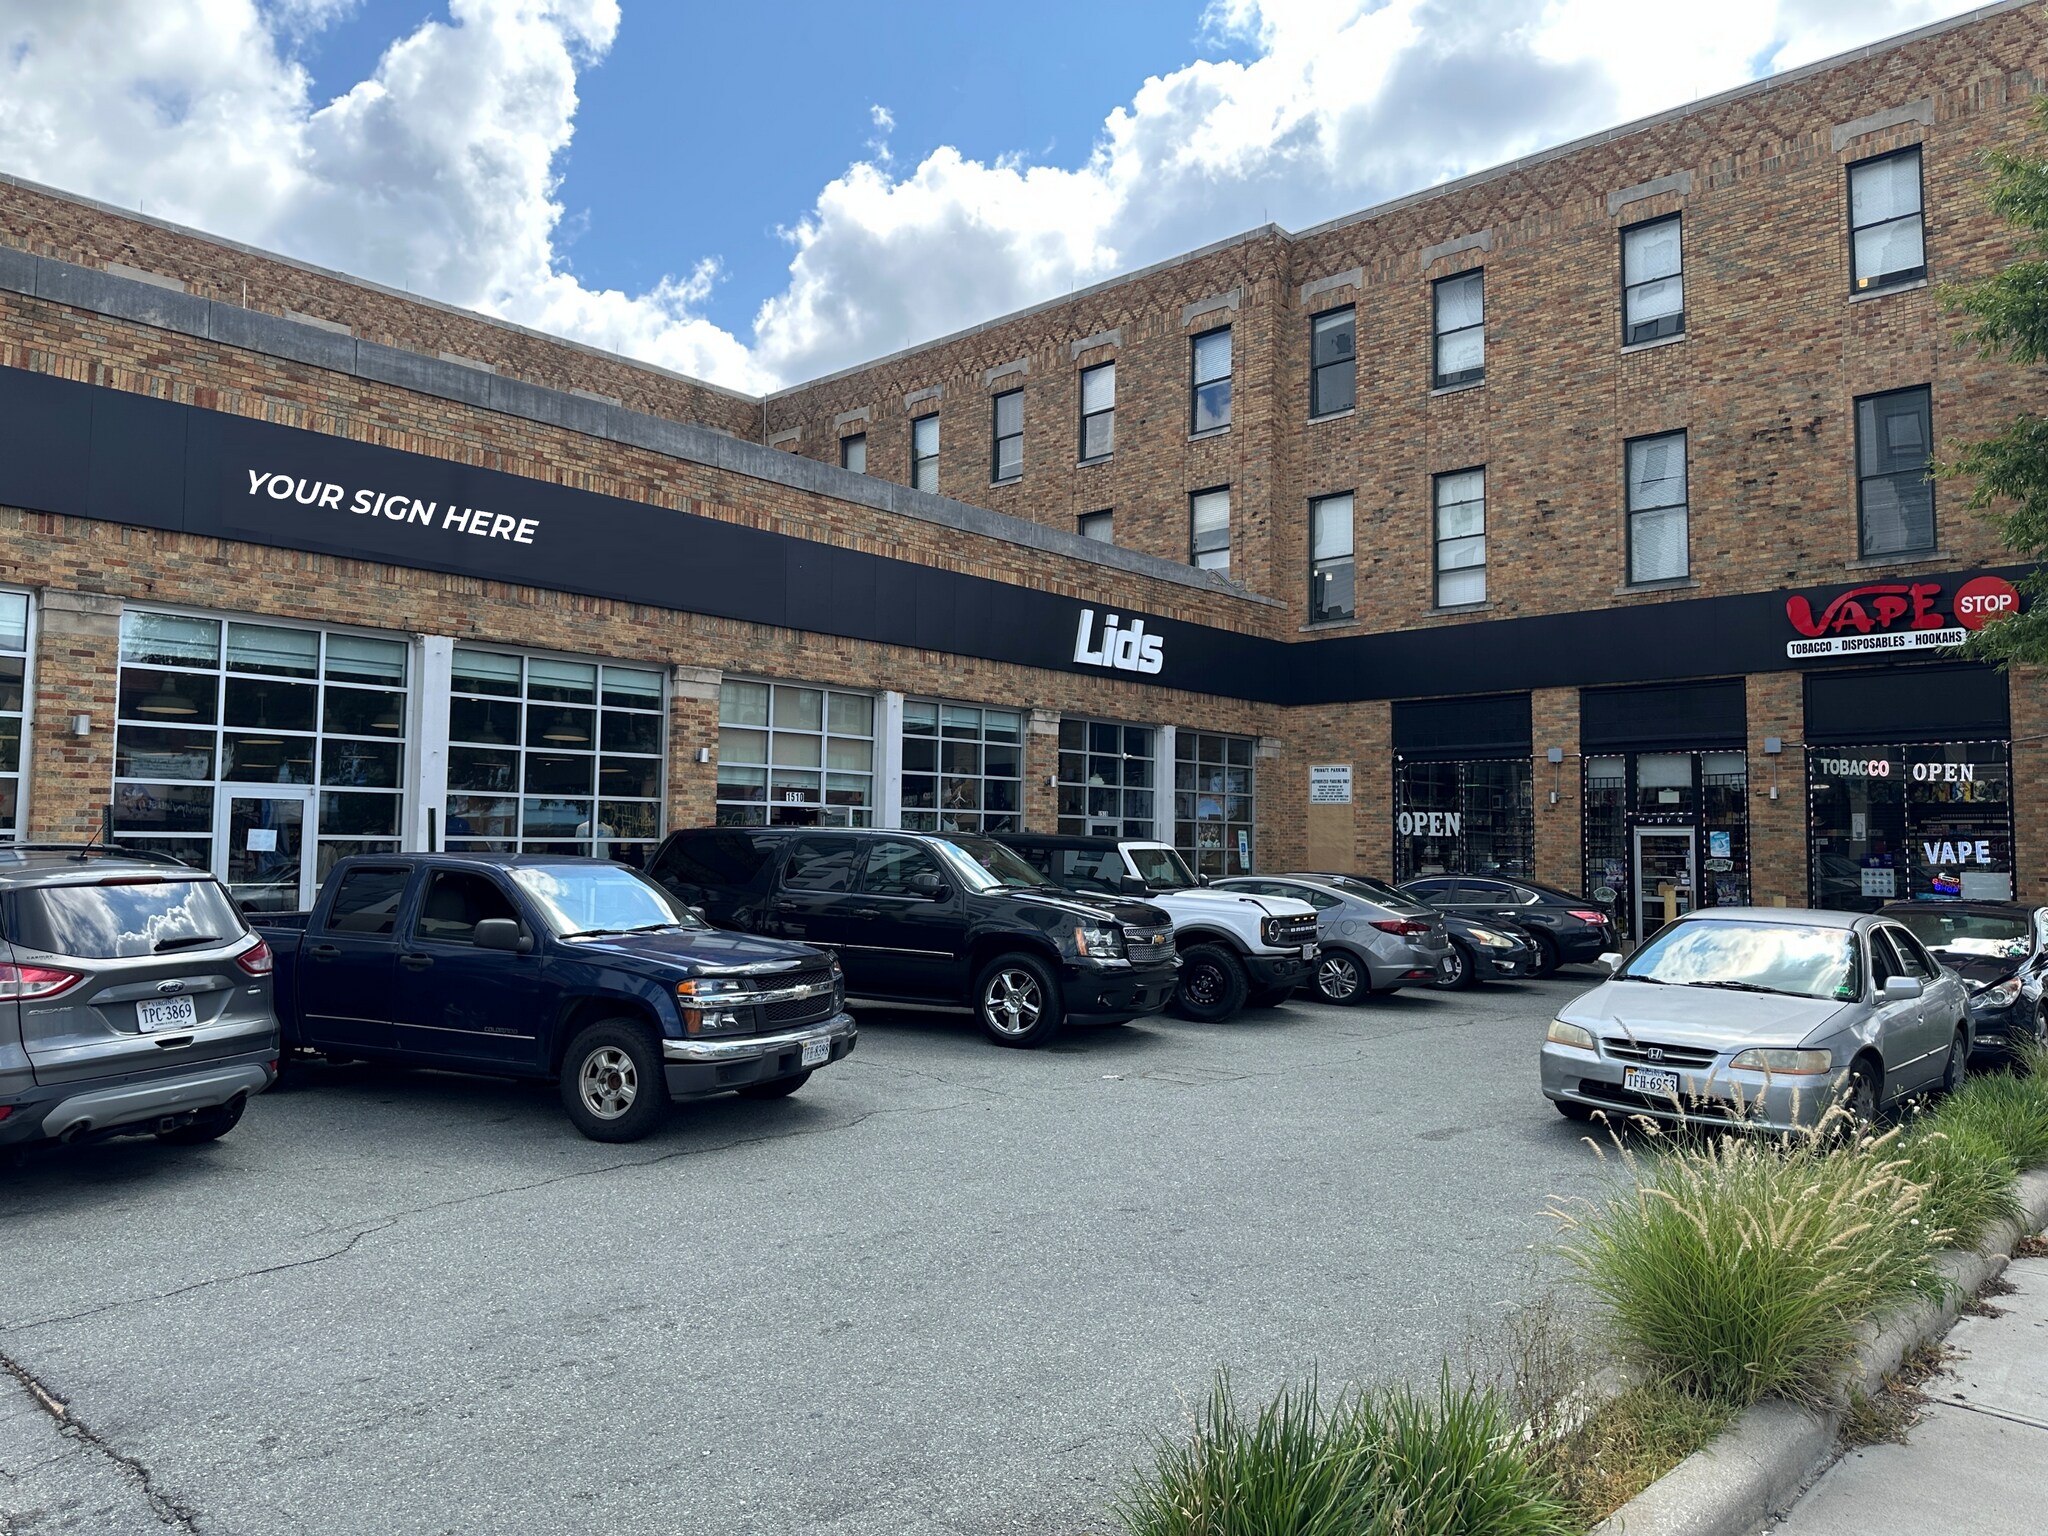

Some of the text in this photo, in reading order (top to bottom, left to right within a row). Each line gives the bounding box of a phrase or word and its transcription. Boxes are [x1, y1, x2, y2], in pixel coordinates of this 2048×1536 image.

[247, 469, 540, 545] YOUR SIGN HERE
[1786, 583, 1945, 637] VAPE
[1960, 594, 2012, 614] STOP
[1073, 608, 1165, 674] Lids
[1790, 641, 1832, 655] TOBACCO
[1841, 635, 1905, 651] DISPOSABLES
[1915, 630, 1962, 646] HOOKAHS
[1820, 758, 1890, 777] TOBACCO
[1912, 763, 1975, 782] OPEN
[787, 793, 804, 802] 1510
[1398, 811, 1462, 837] OPEN
[1923, 840, 1991, 865] VAPE
[142, 1004, 192, 1023] TPC-3869
[151, 999, 179, 1008] VIRGINIA
[1628, 1074, 1675, 1092] TFH-6953
